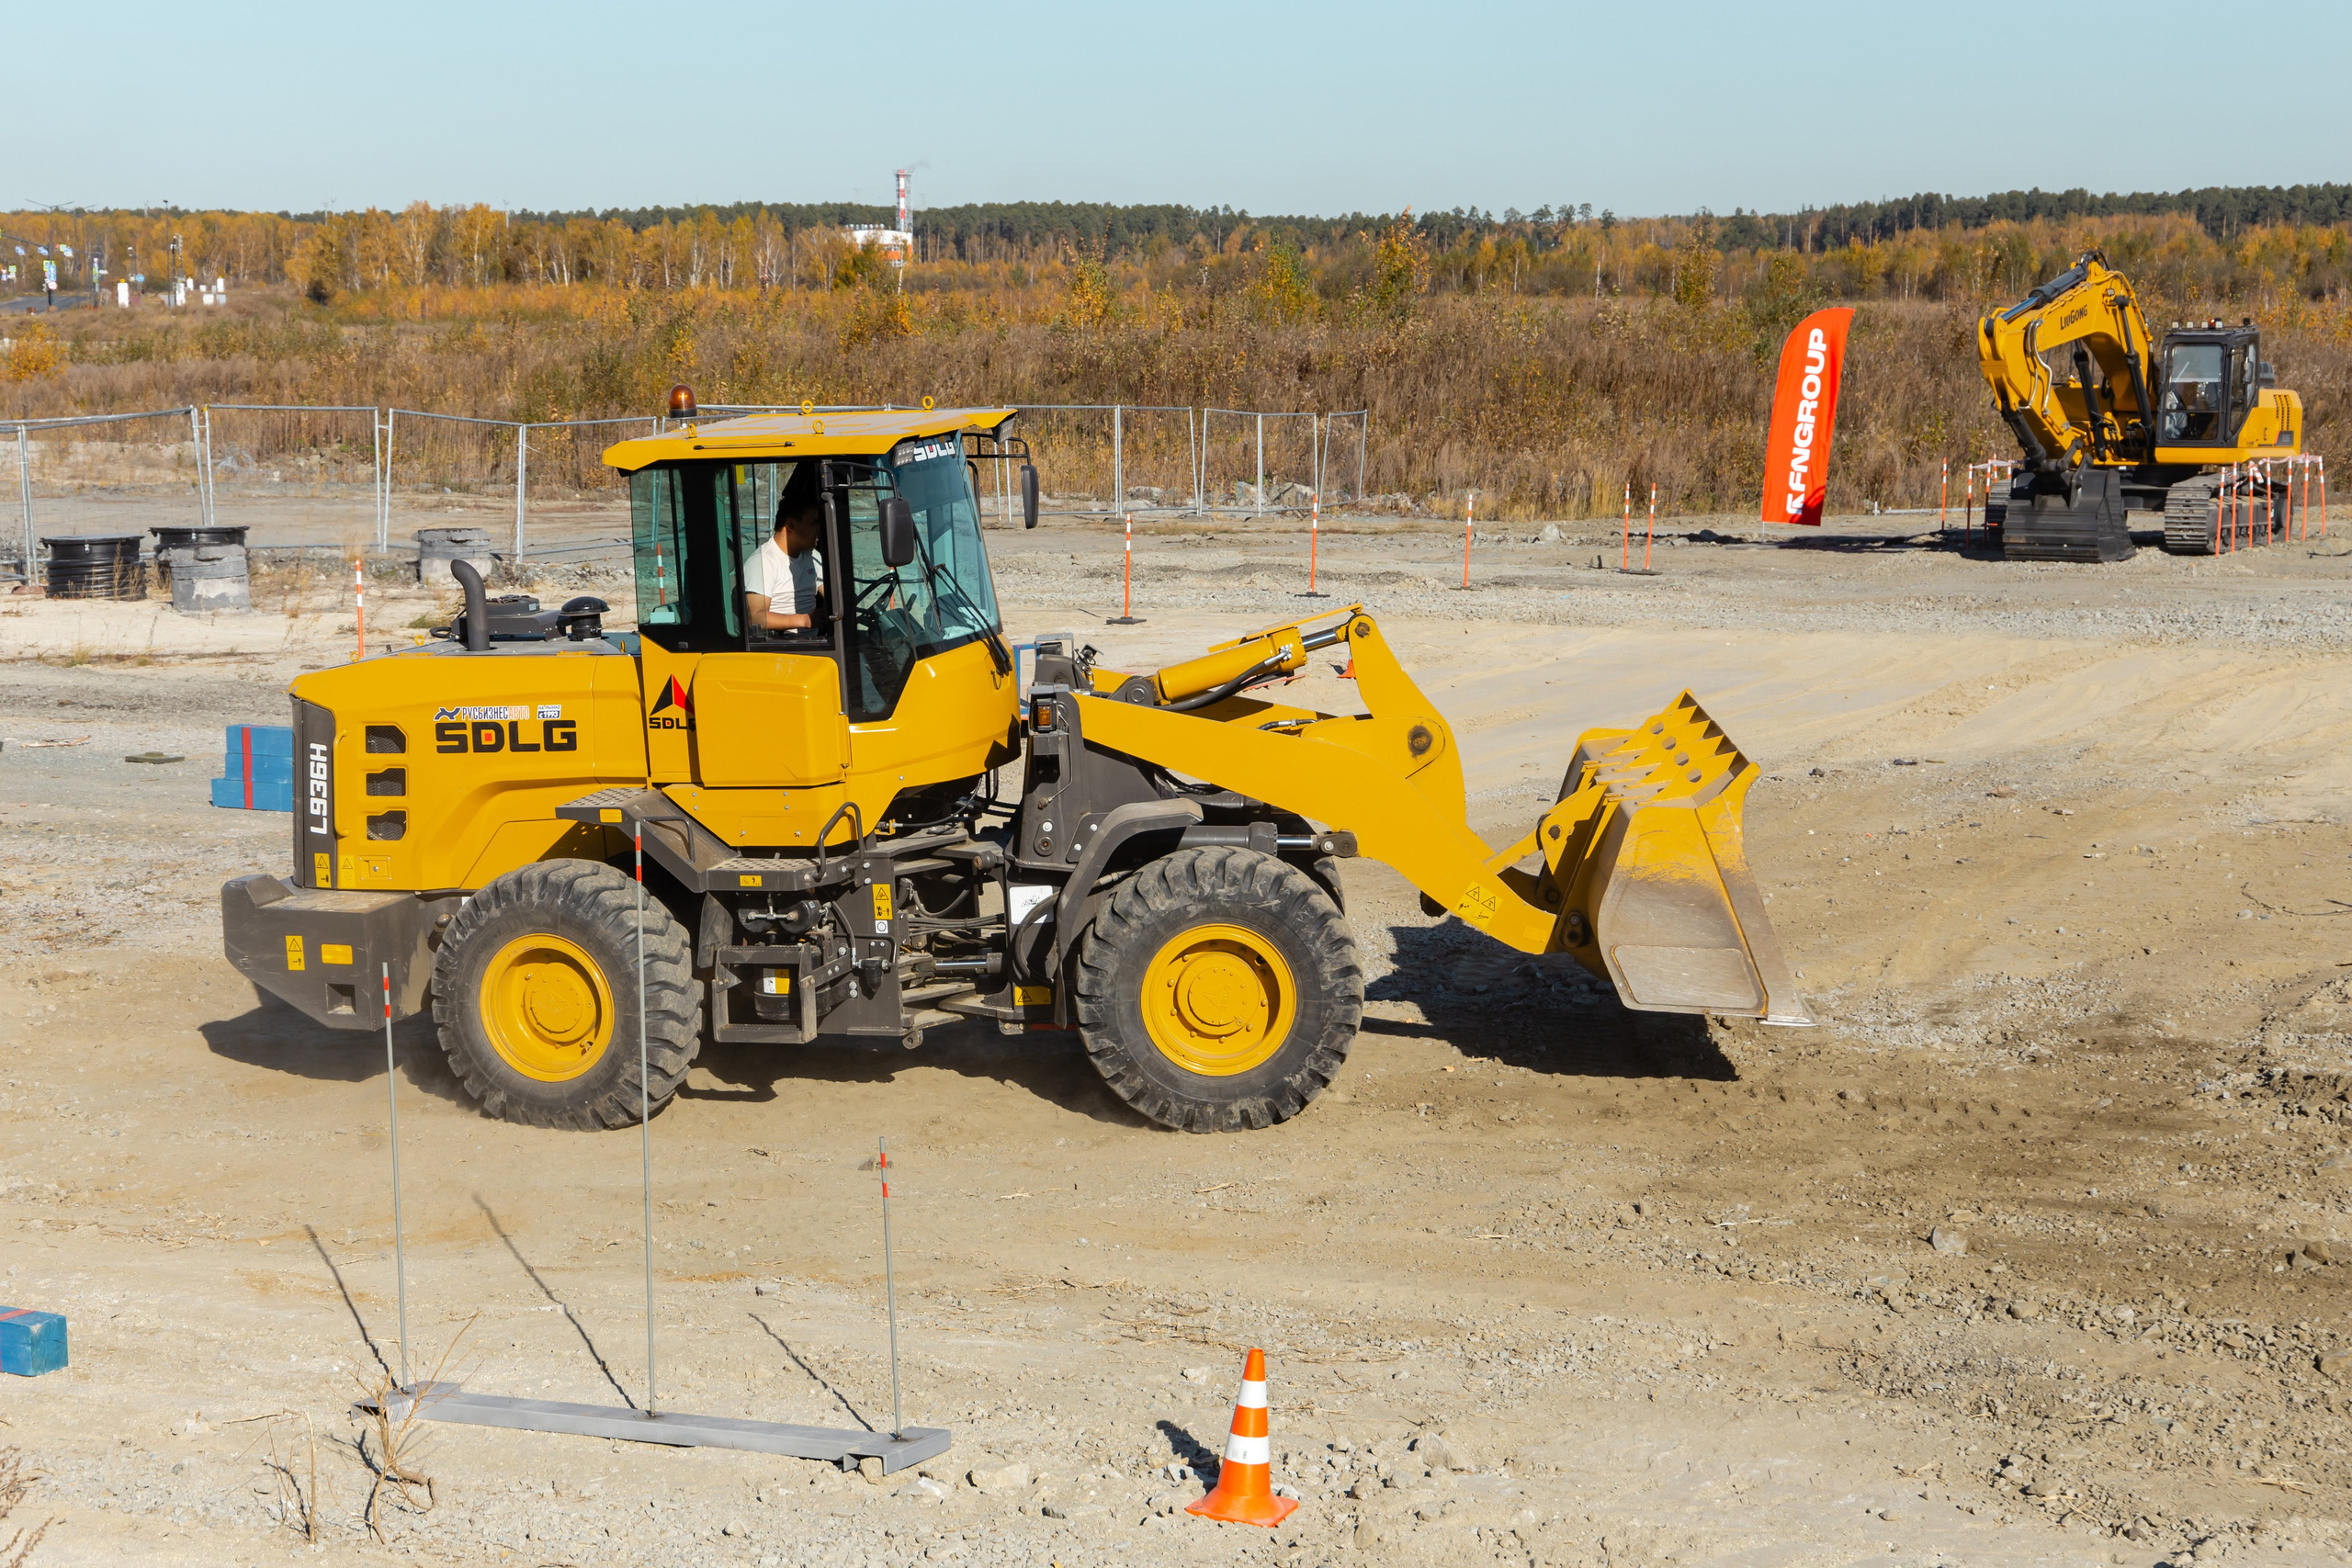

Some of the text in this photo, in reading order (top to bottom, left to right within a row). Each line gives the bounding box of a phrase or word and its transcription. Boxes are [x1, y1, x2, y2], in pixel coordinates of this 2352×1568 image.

[462, 706, 529, 720] РУСБИЗНЕСАВТО
[435, 720, 577, 753] SDLG
[310, 742, 327, 834] L936H
